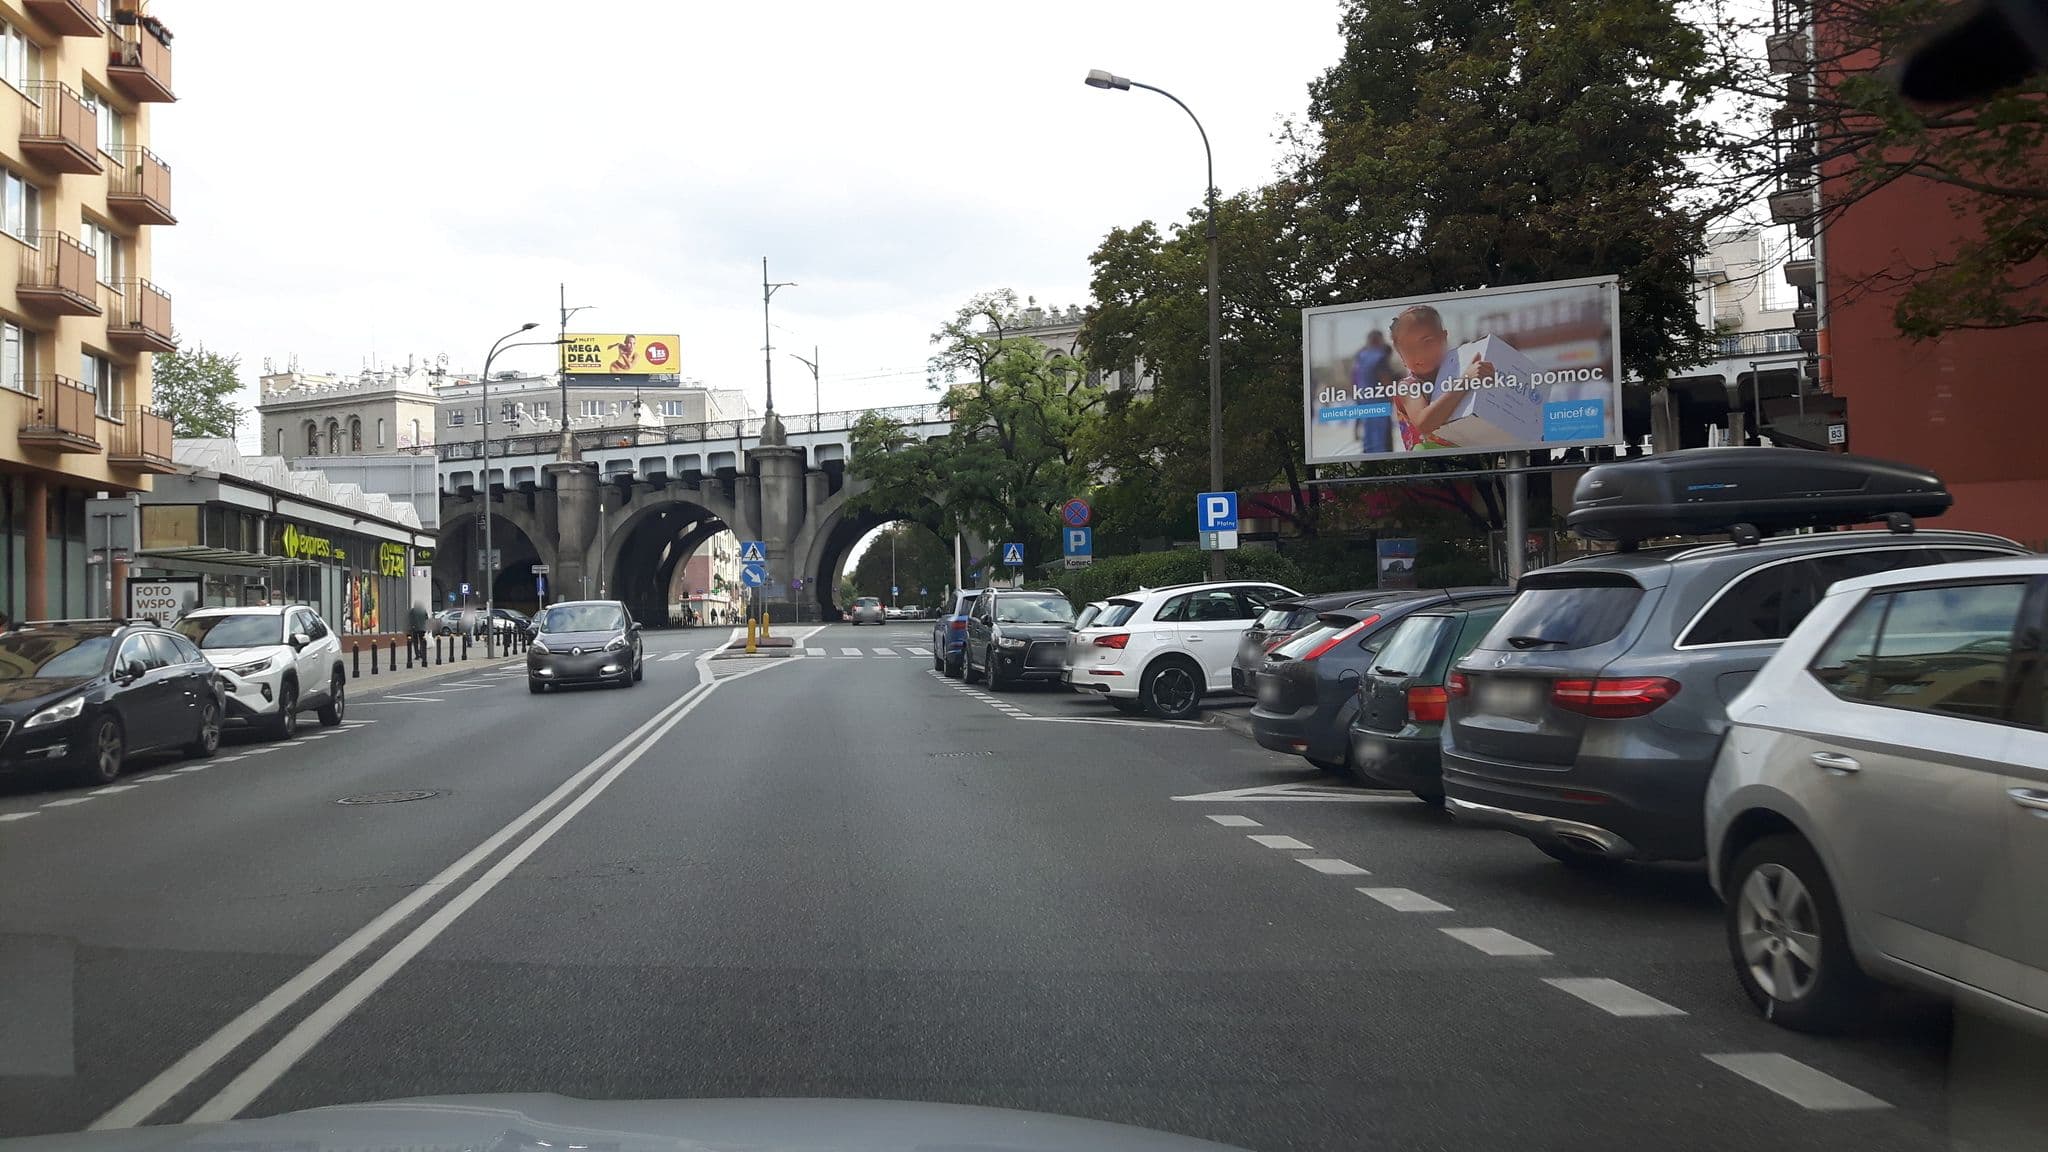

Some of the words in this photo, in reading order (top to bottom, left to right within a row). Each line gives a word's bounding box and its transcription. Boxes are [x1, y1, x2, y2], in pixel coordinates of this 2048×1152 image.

[568, 344, 601, 353] MEGA
[568, 354, 601, 363] DEAL
[1318, 387, 1347, 403] dla
[1353, 381, 1434, 400] każdego
[1440, 371, 1523, 392] dziecka,
[1531, 367, 1604, 389] pomoc
[1322, 407, 1386, 418] unicef.pl/pomoc
[1549, 406, 1584, 420] unicef
[1831, 430, 1842, 438] 83
[1207, 497, 1229, 527] P
[300, 535, 330, 557] express
[1070, 530, 1086, 552] P
[136, 586, 171, 596] FOTO
[136, 599, 176, 608] WSPO
